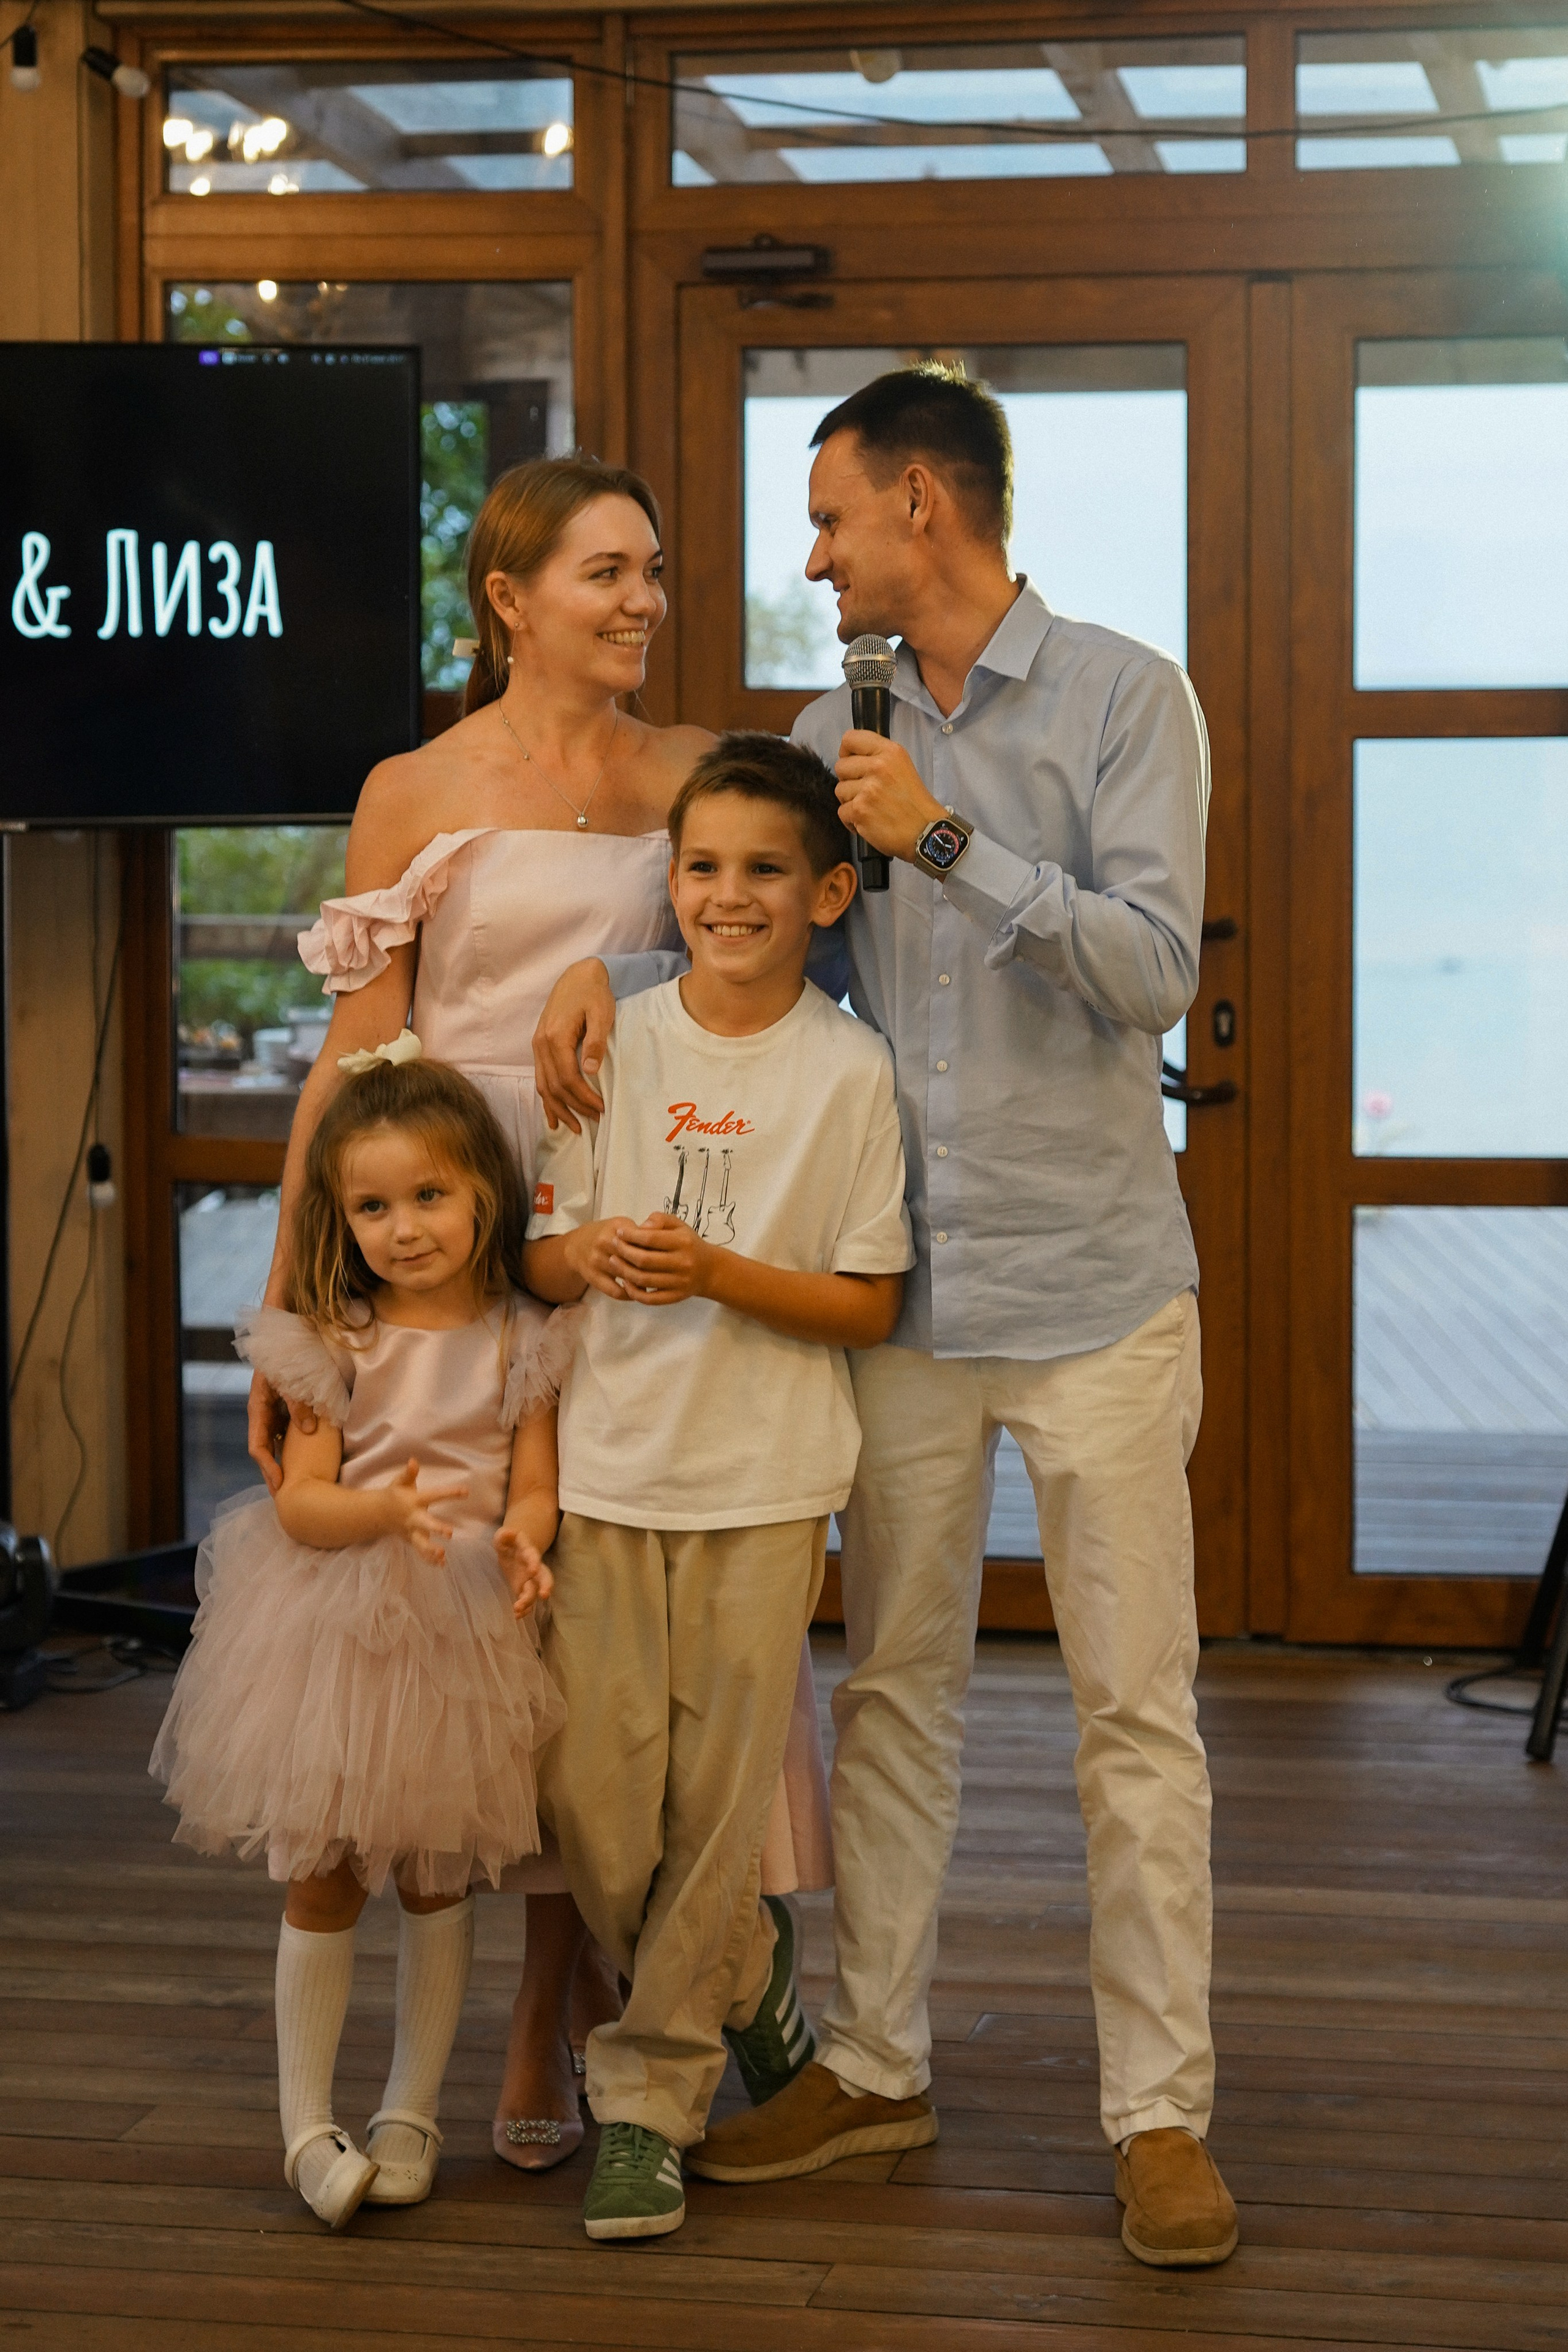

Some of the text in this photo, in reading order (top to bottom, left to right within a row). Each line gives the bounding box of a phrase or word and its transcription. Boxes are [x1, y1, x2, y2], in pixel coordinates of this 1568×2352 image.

[12, 528, 284, 641] & ЛИЗА
[665, 1101, 755, 1143] Fender
